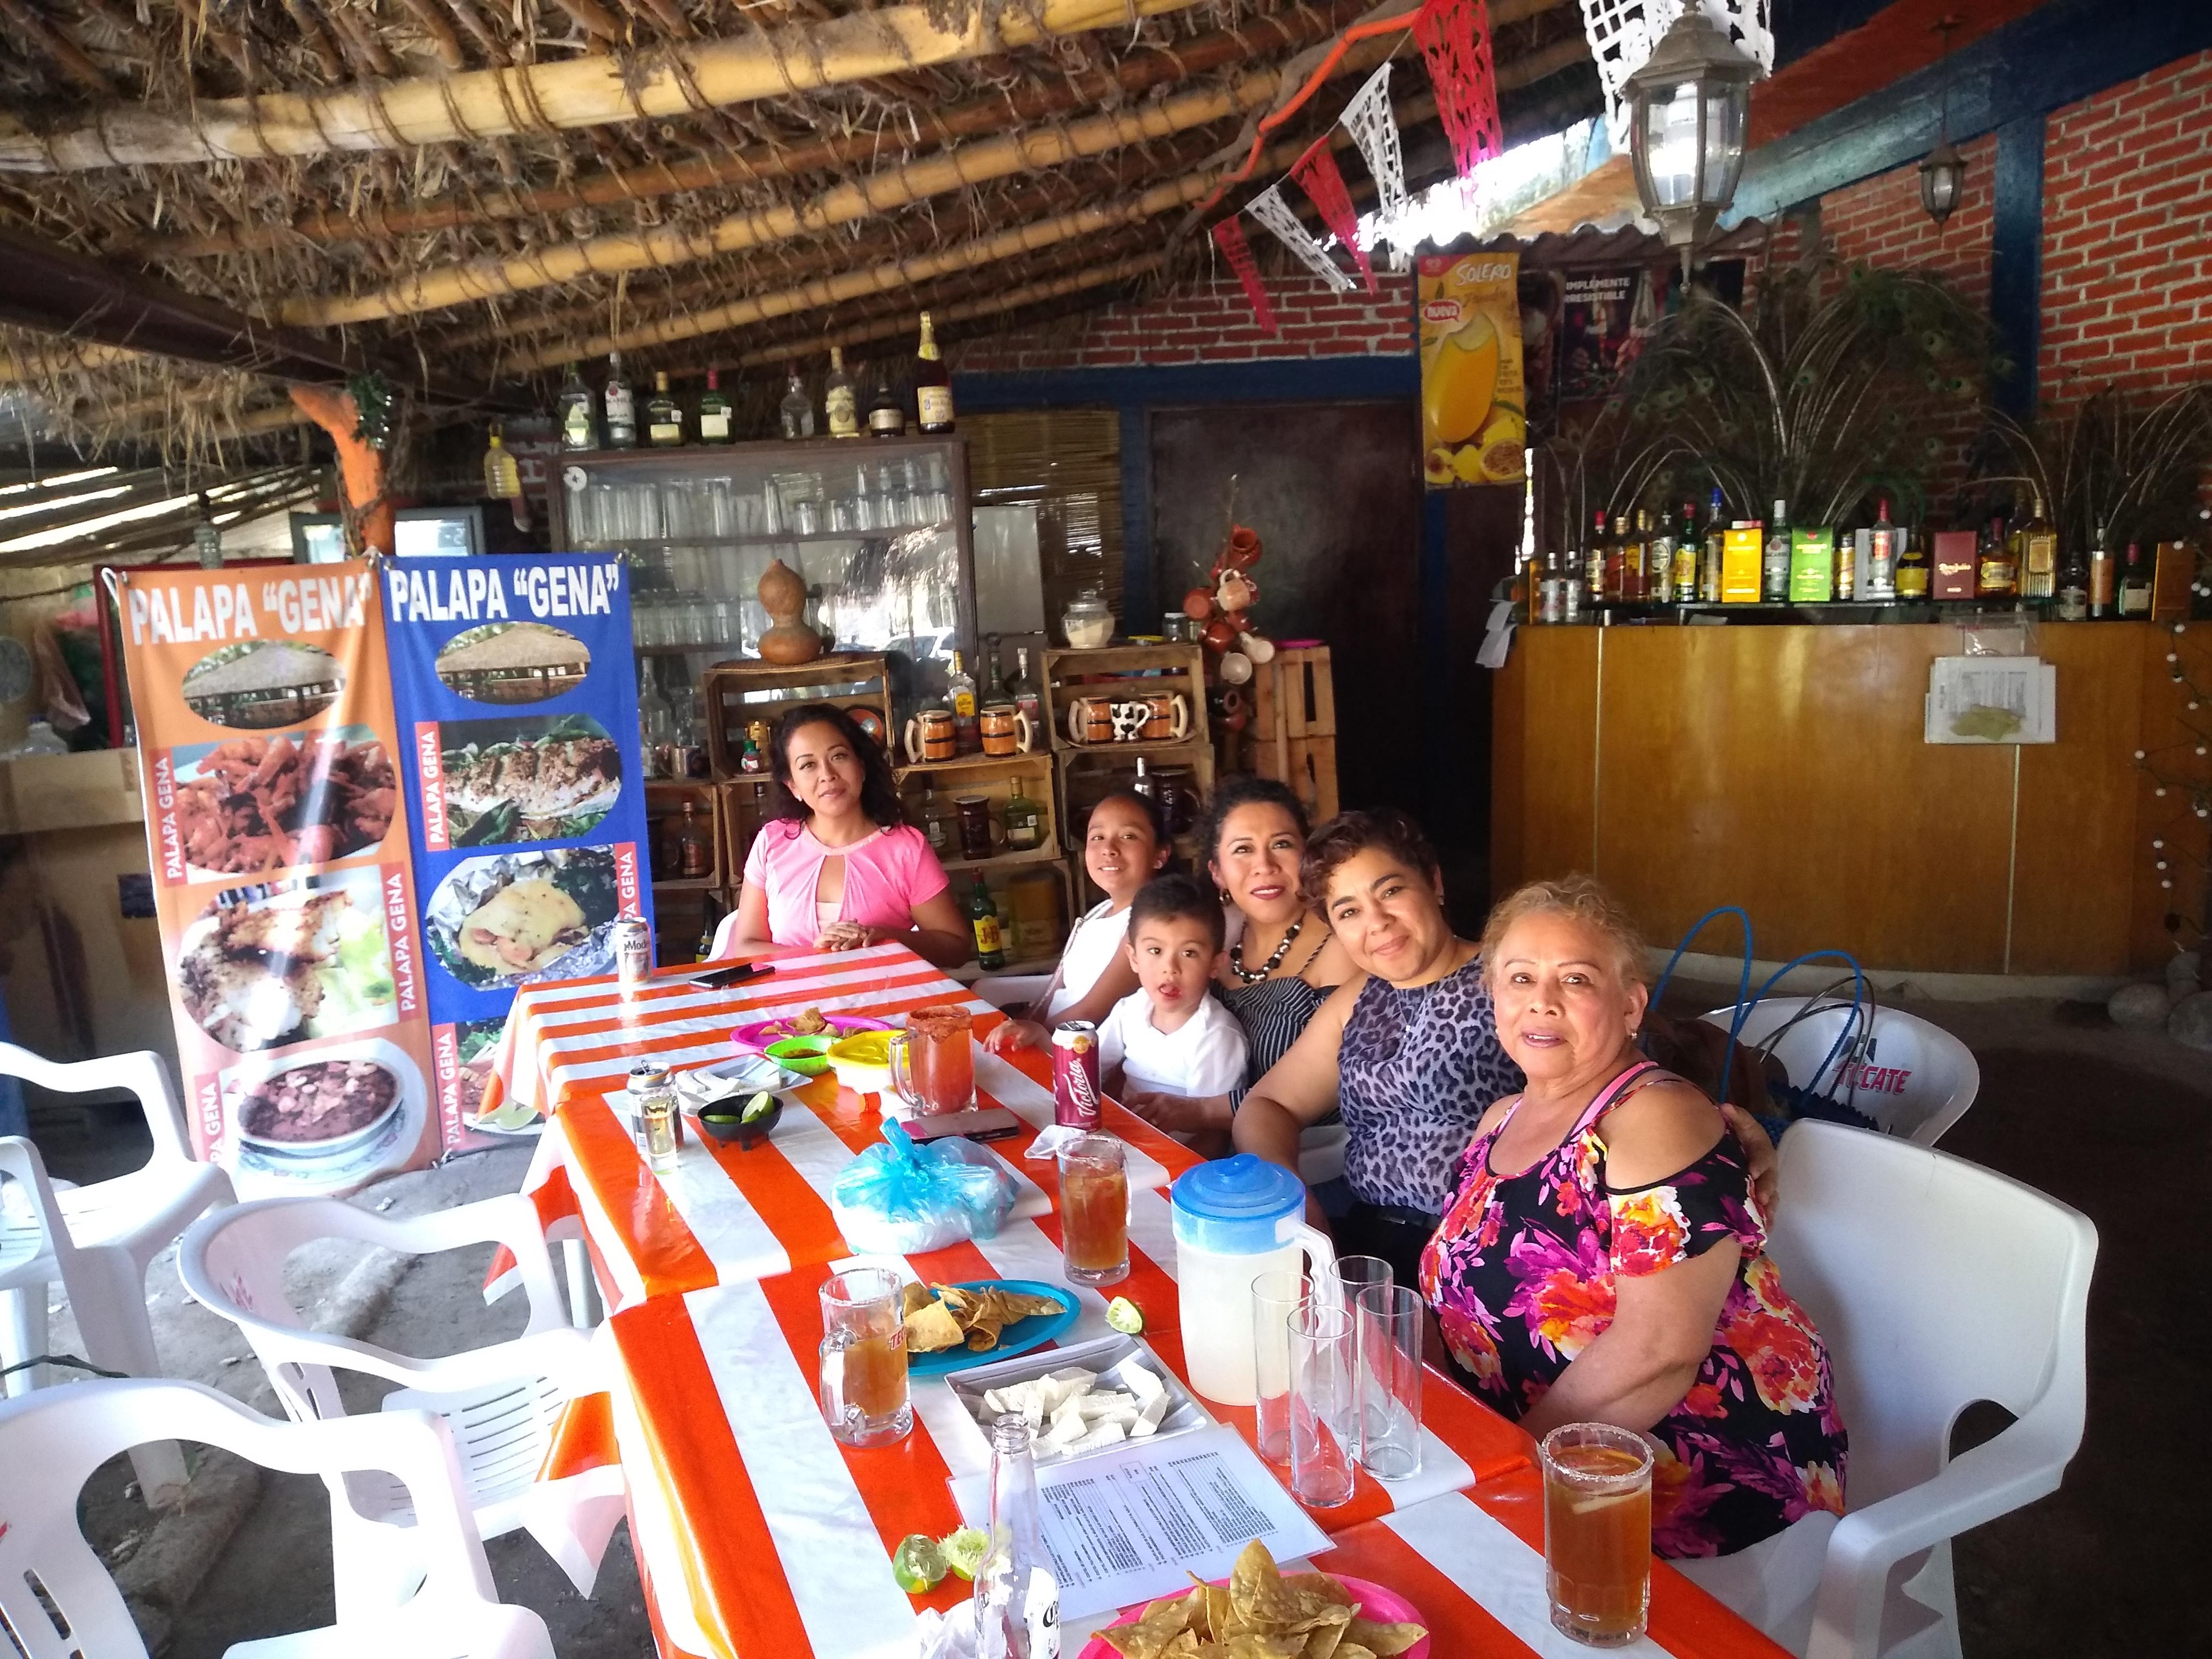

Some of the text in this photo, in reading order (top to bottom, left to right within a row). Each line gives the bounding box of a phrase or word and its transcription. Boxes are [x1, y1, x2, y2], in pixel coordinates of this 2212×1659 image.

[1455, 263, 1512, 286] SOLERO
[1565, 277, 1631, 291] IMPLEMENTE
[129, 583, 259, 645] PALAPA
[390, 568, 508, 622] PALAPA
[421, 731, 445, 843] PALAPA GENA
[155, 757, 183, 878] PALAPA GENA
[621, 851, 635, 899] GENA
[386, 873, 415, 1011] PALAPA GENA
[202, 1083, 221, 1135] GENA
[437, 1032, 461, 1145] PALAPA GENA
[1062, 1058, 1100, 1118] Victoria
